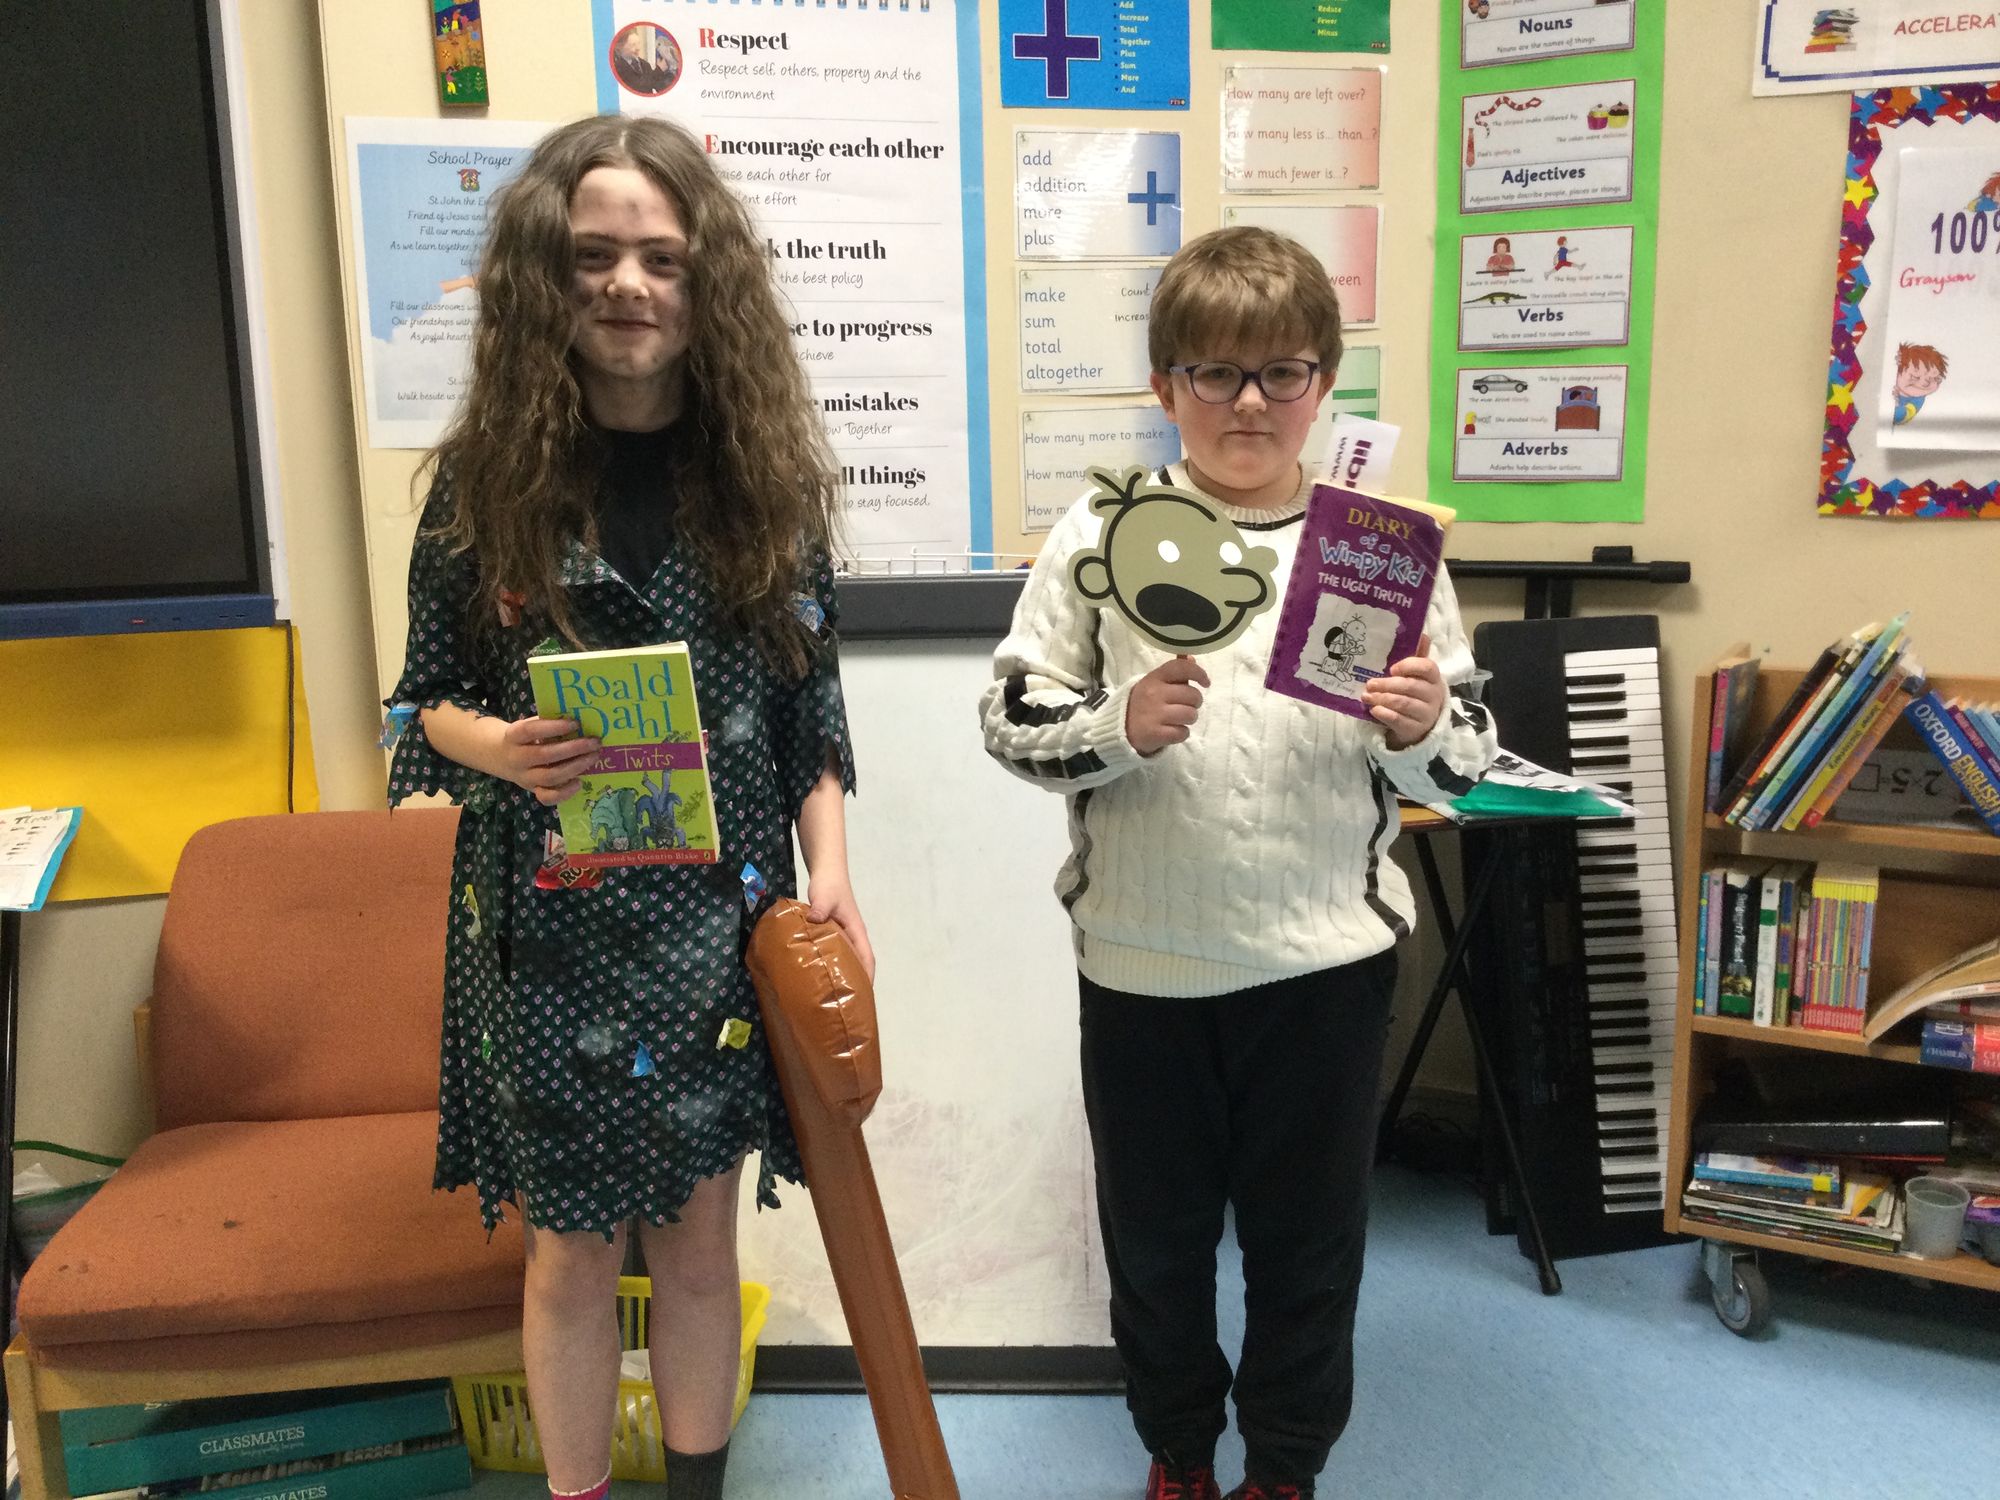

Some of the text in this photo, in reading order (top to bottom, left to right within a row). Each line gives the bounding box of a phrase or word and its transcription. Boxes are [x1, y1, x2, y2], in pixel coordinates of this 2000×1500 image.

[1119, 1, 1134, 9] Add
[1119, 13, 1149, 22] Increase
[1519, 18, 1573, 34] Nouns
[1893, 12, 2000, 36] ACCELERA
[698, 27, 790, 55] Respect
[1317, 29, 1338, 37] Minus
[1120, 38, 1151, 47] Together
[1120, 49, 1136, 57] Plus
[698, 60, 748, 80] Respect
[824, 67, 870, 83] property
[874, 67, 899, 81] and
[903, 67, 922, 82] the
[700, 88, 775, 101] environment
[1227, 87, 1366, 104] How many are left over?
[1257, 130, 1288, 144] many
[1293, 127, 1313, 140] less
[705, 134, 944, 162] Encourage each other
[428, 151, 513, 170] School Prayer
[1022, 150, 1052, 166] add
[746, 168, 832, 182] each other for
[1257, 165, 1288, 179] much
[1291, 167, 1321, 183] fewer
[1501, 167, 1586, 188] Adjectives
[440, 197, 461, 206] John
[764, 191, 798, 205] effort
[408, 211, 434, 220] Friend
[416, 241, 436, 250] learn
[1024, 229, 1056, 251] plus
[787, 239, 823, 259] the
[828, 240, 886, 260] truth
[780, 271, 799, 284] the
[803, 271, 827, 284] best
[831, 272, 864, 288] policy
[1024, 286, 1066, 303] make
[1024, 315, 1056, 329] sum
[1518, 308, 1564, 322] Verbs
[813, 320, 932, 343] to progress
[799, 348, 835, 361] chieve
[1025, 338, 1062, 354] total
[1026, 363, 1104, 385] altogether
[824, 392, 919, 412] mistakes
[845, 422, 892, 440] Together
[1025, 433, 1050, 444] How
[1054, 434, 1085, 446] many
[1088, 432, 1116, 442] more
[1120, 430, 1131, 440] to
[1502, 442, 1568, 456] Adverbs
[860, 466, 926, 489] things
[1026, 469, 1086, 482] How many
[857, 494, 931, 512] stay focused.
[1027, 505, 1053, 516] How
[1347, 507, 1416, 540] DIARY
[1359, 532, 1391, 553] of a
[1318, 536, 1426, 588] Wimpy Kid
[1317, 572, 1414, 609] THE UGLY TRUTH
[547, 660, 680, 714] Roald
[569, 701, 673, 739] Dahl
[614, 747, 675, 770] Twits
[1914, 703, 1962, 760] OXFORD
[1956, 752, 2000, 810] ENGLISH
[637, 853, 673, 862] Quentin
[675, 852, 700, 861] Blake
[199, 1426, 305, 1454] CLASSMATES
